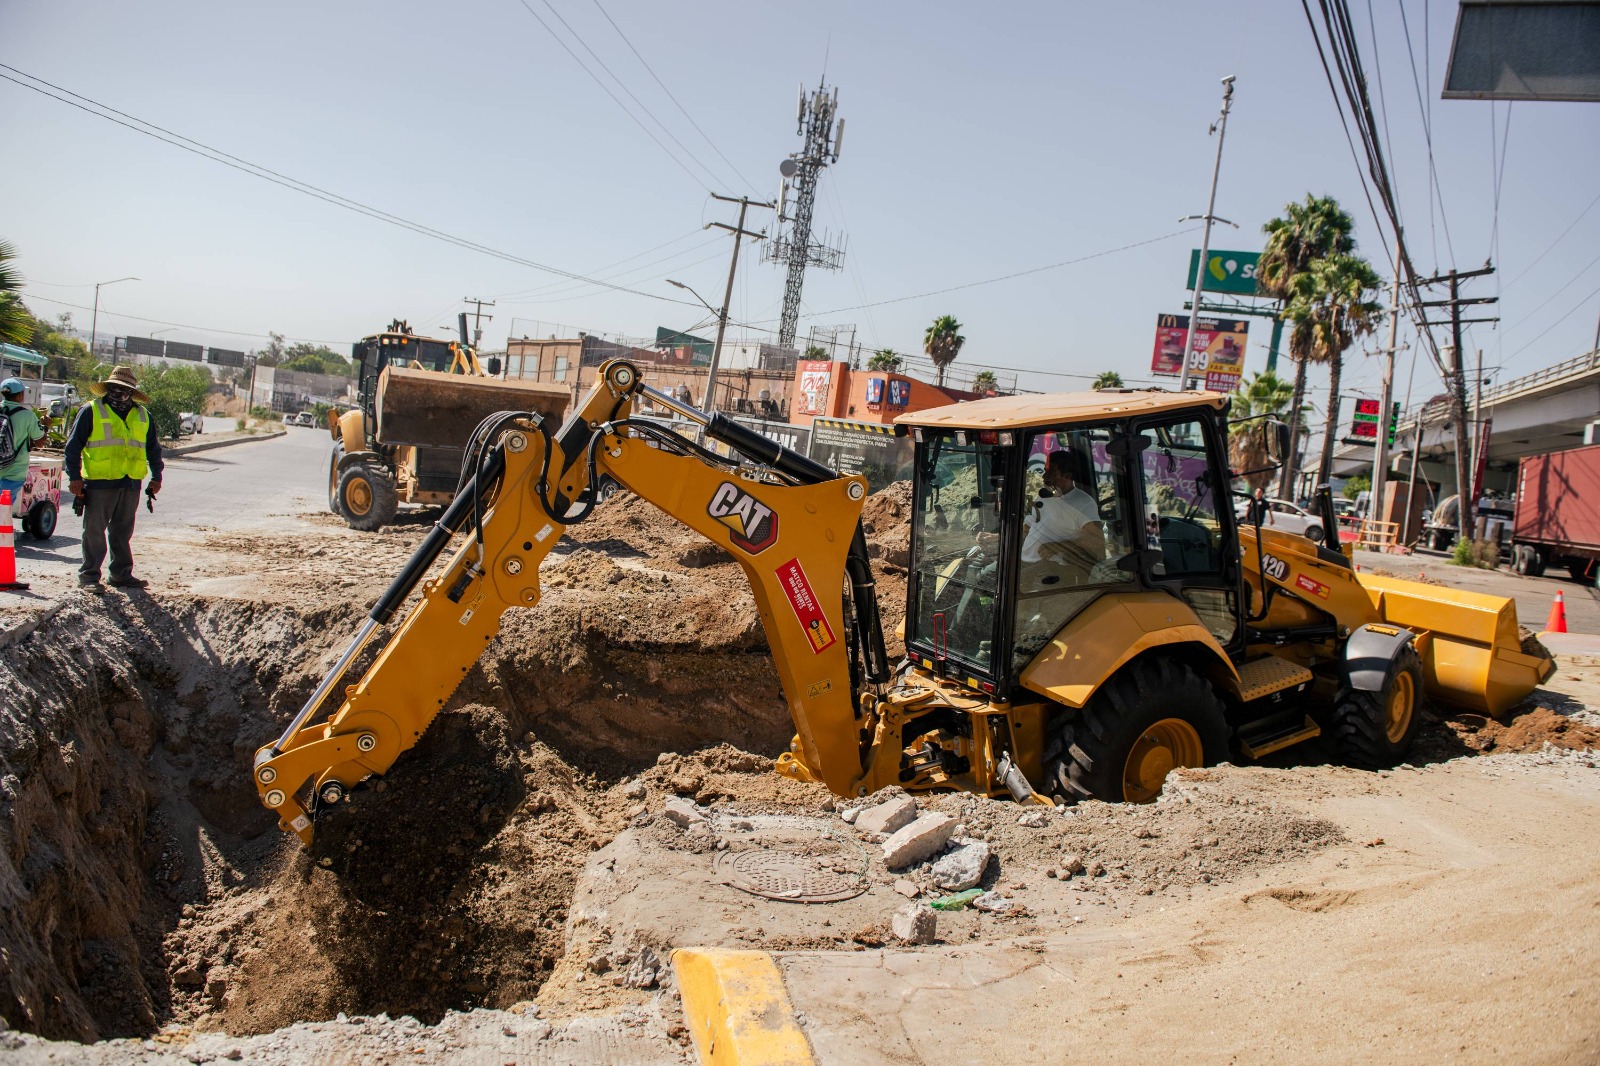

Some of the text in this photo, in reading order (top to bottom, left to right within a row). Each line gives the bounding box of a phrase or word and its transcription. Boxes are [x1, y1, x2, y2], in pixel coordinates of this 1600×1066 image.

[708, 481, 772, 539] CAT
[789, 566, 804, 588] MATCO
[800, 587, 815, 612] RENTAS
